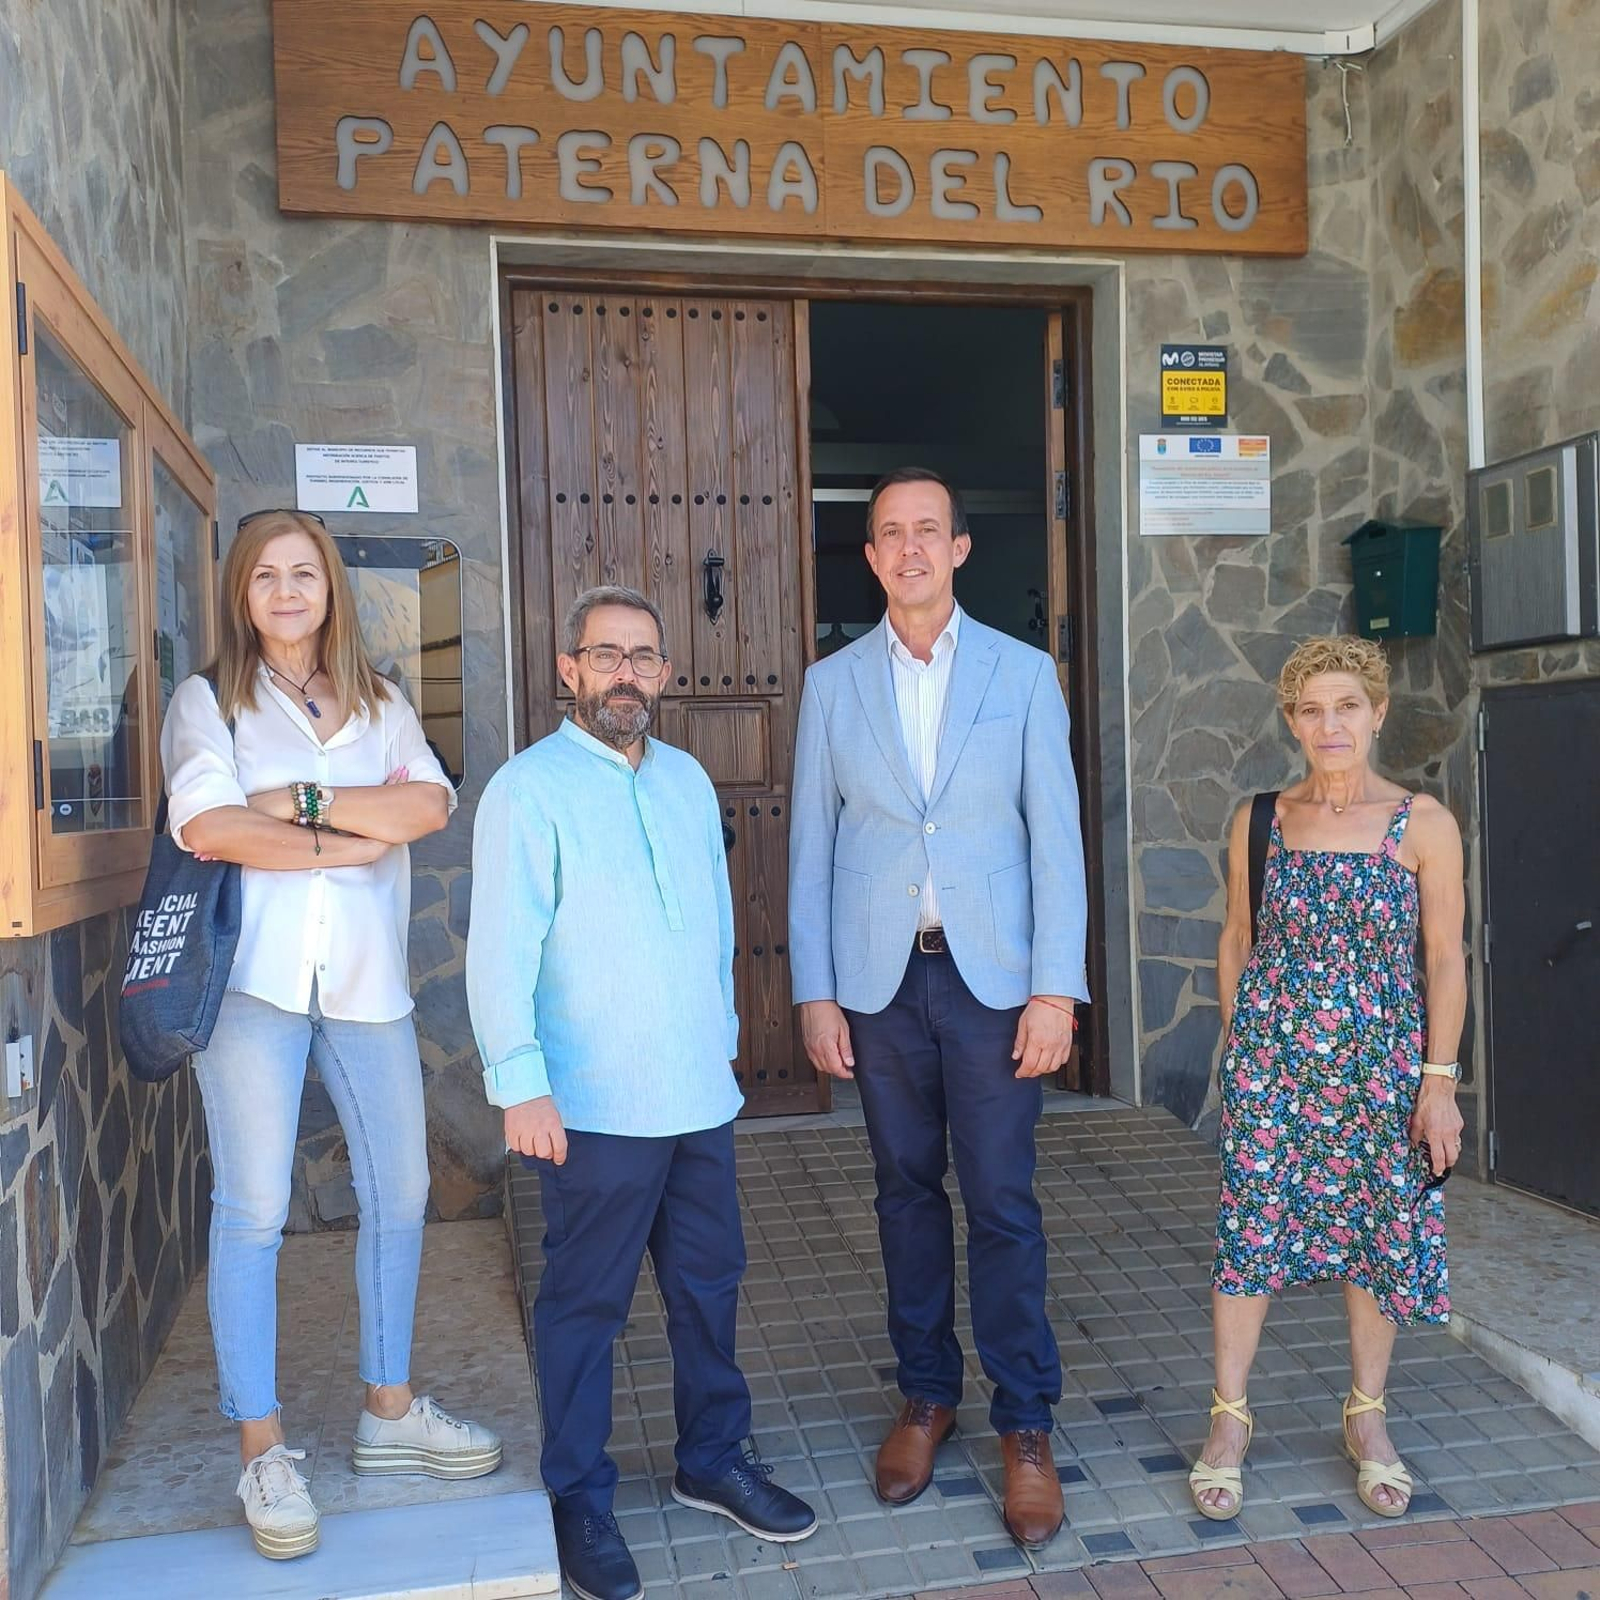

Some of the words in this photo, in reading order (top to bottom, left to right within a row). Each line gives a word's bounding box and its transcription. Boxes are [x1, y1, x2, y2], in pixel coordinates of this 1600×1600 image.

[398, 15, 1211, 134] AYUNTAMIENTO
[334, 114, 820, 214] PATERNA
[862, 144, 1045, 223] DEL
[1087, 156, 1260, 232] RIO
[1167, 378, 1221, 386] CONECTADA
